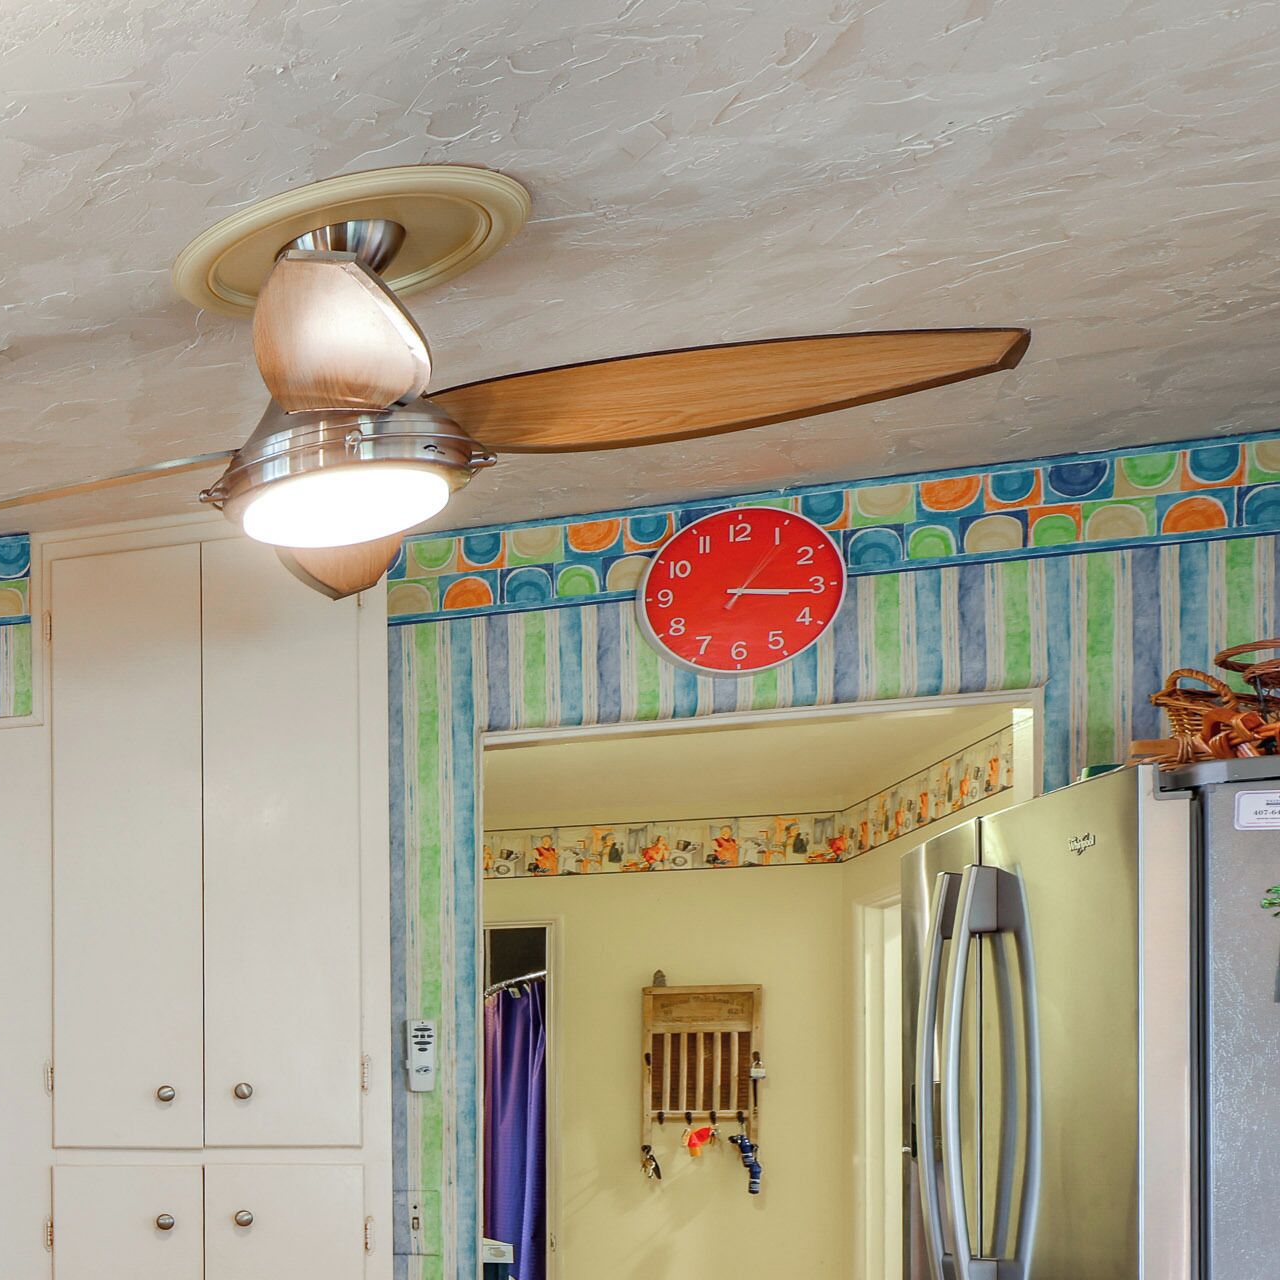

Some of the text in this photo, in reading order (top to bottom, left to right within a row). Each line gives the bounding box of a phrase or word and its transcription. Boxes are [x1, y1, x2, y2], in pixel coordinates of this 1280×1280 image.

[729, 523, 751, 542] 12
[775, 527, 780, 545] 1
[699, 536, 710, 554] 11
[796, 546, 813, 565] 2
[669, 560, 691, 579] 10
[808, 575, 825, 594] 3
[657, 589, 674, 608] 9
[796, 607, 812, 625] 4
[669, 618, 685, 636] 8
[696, 636, 712, 654] 7
[768, 630, 784, 649] 5
[731, 641, 747, 660] 6
